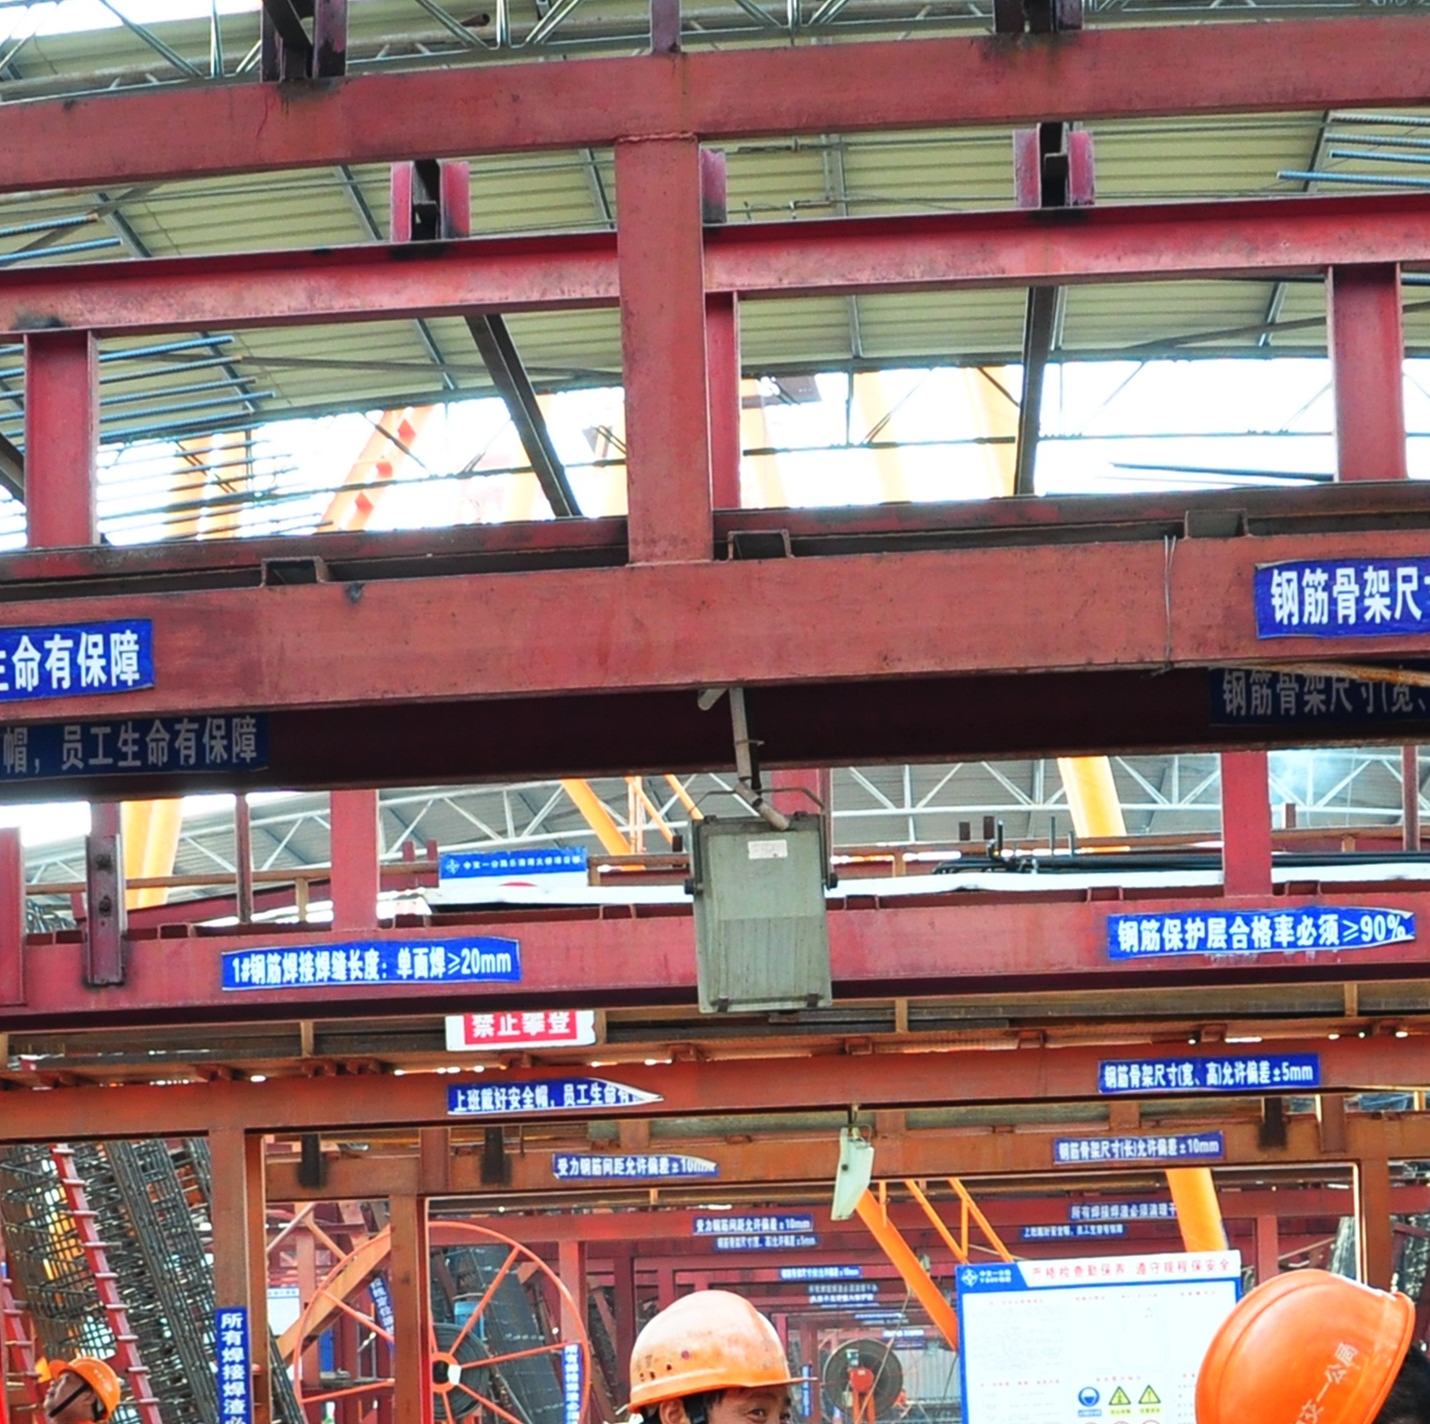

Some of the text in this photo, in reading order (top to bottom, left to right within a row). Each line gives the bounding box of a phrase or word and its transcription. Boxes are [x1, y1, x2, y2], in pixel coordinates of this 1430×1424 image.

[1118, 913, 1408, 952] 钢筋保护层合格率必须≥90%
[472, 1010, 571, 1039] 禁止攀登
